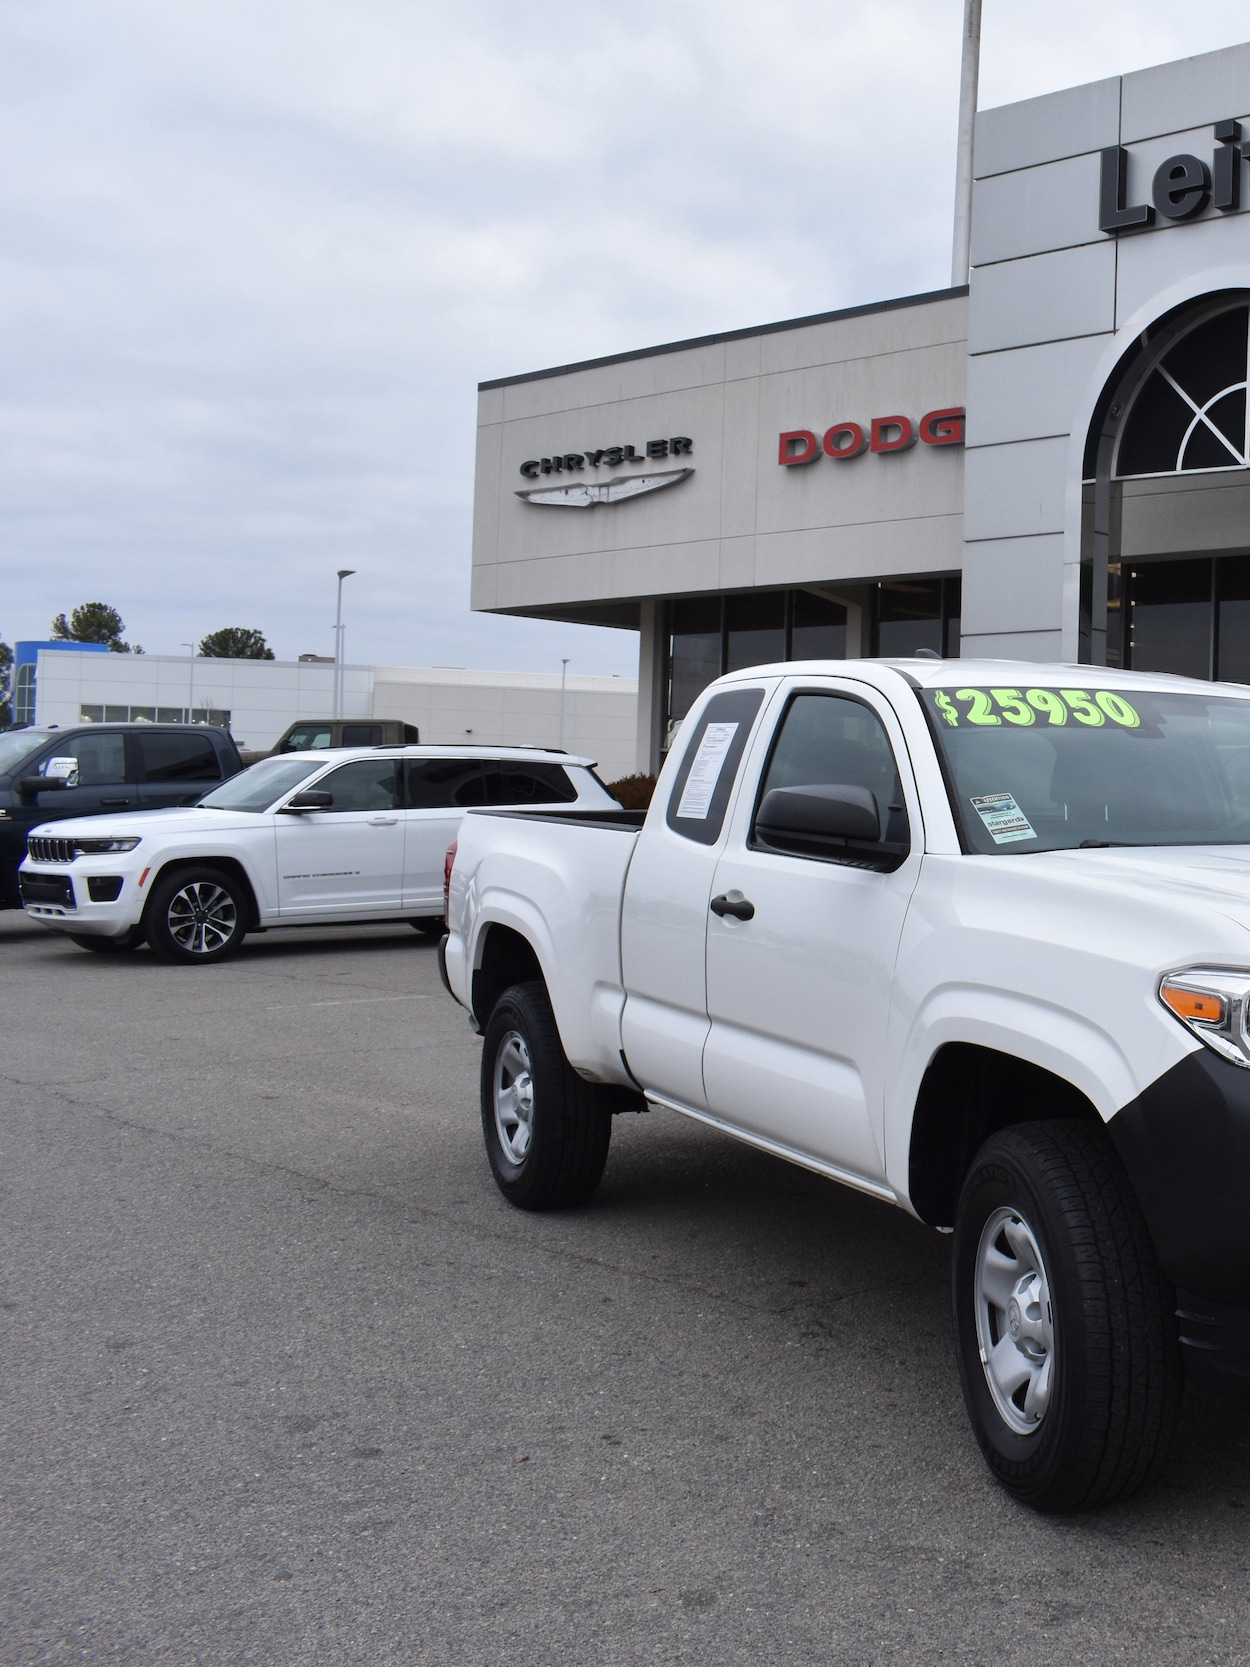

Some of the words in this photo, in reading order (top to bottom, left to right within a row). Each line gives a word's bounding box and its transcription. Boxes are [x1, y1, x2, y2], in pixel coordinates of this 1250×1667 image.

[519, 436, 694, 479] CHRYSLER
[778, 407, 966, 468] DODG
[934, 688, 1141, 728] $25950
